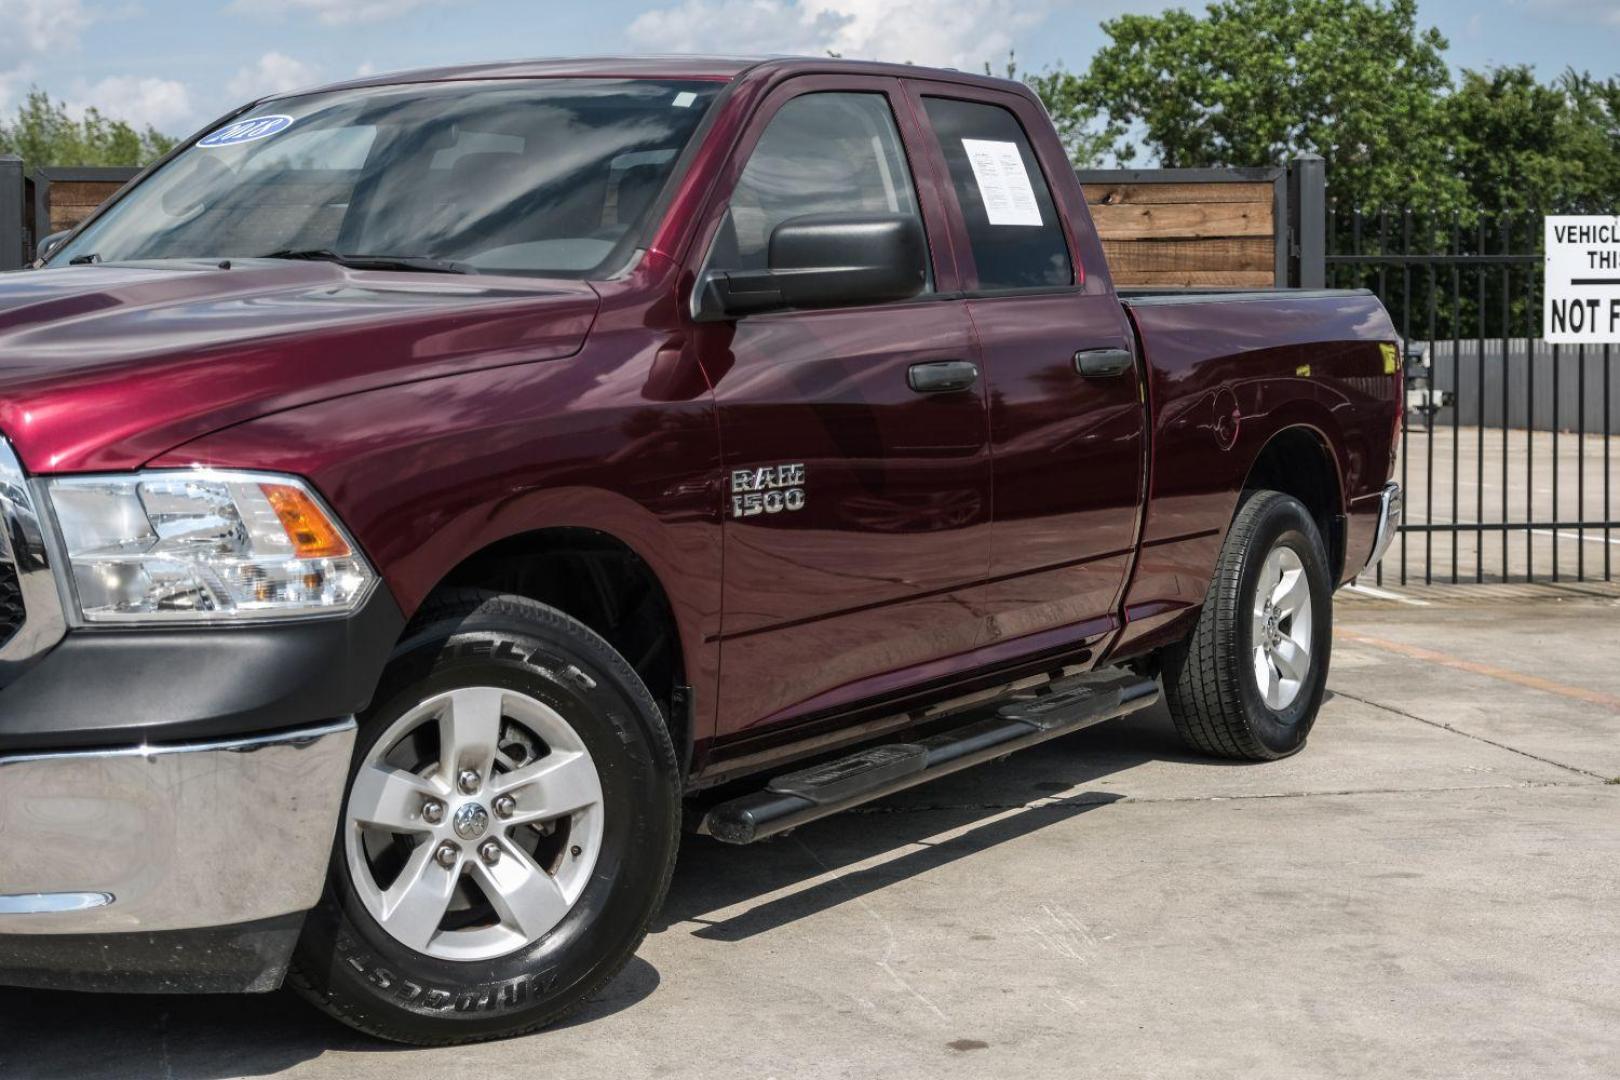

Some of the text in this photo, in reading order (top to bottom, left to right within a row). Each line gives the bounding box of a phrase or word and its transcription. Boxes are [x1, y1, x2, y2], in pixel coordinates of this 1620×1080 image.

[1554, 225, 1620, 243] VEHICL
[1587, 250, 1620, 269] THI
[1551, 299, 1600, 333] NOT
[731, 463, 805, 493] RAM
[731, 488, 805, 518] 1500
